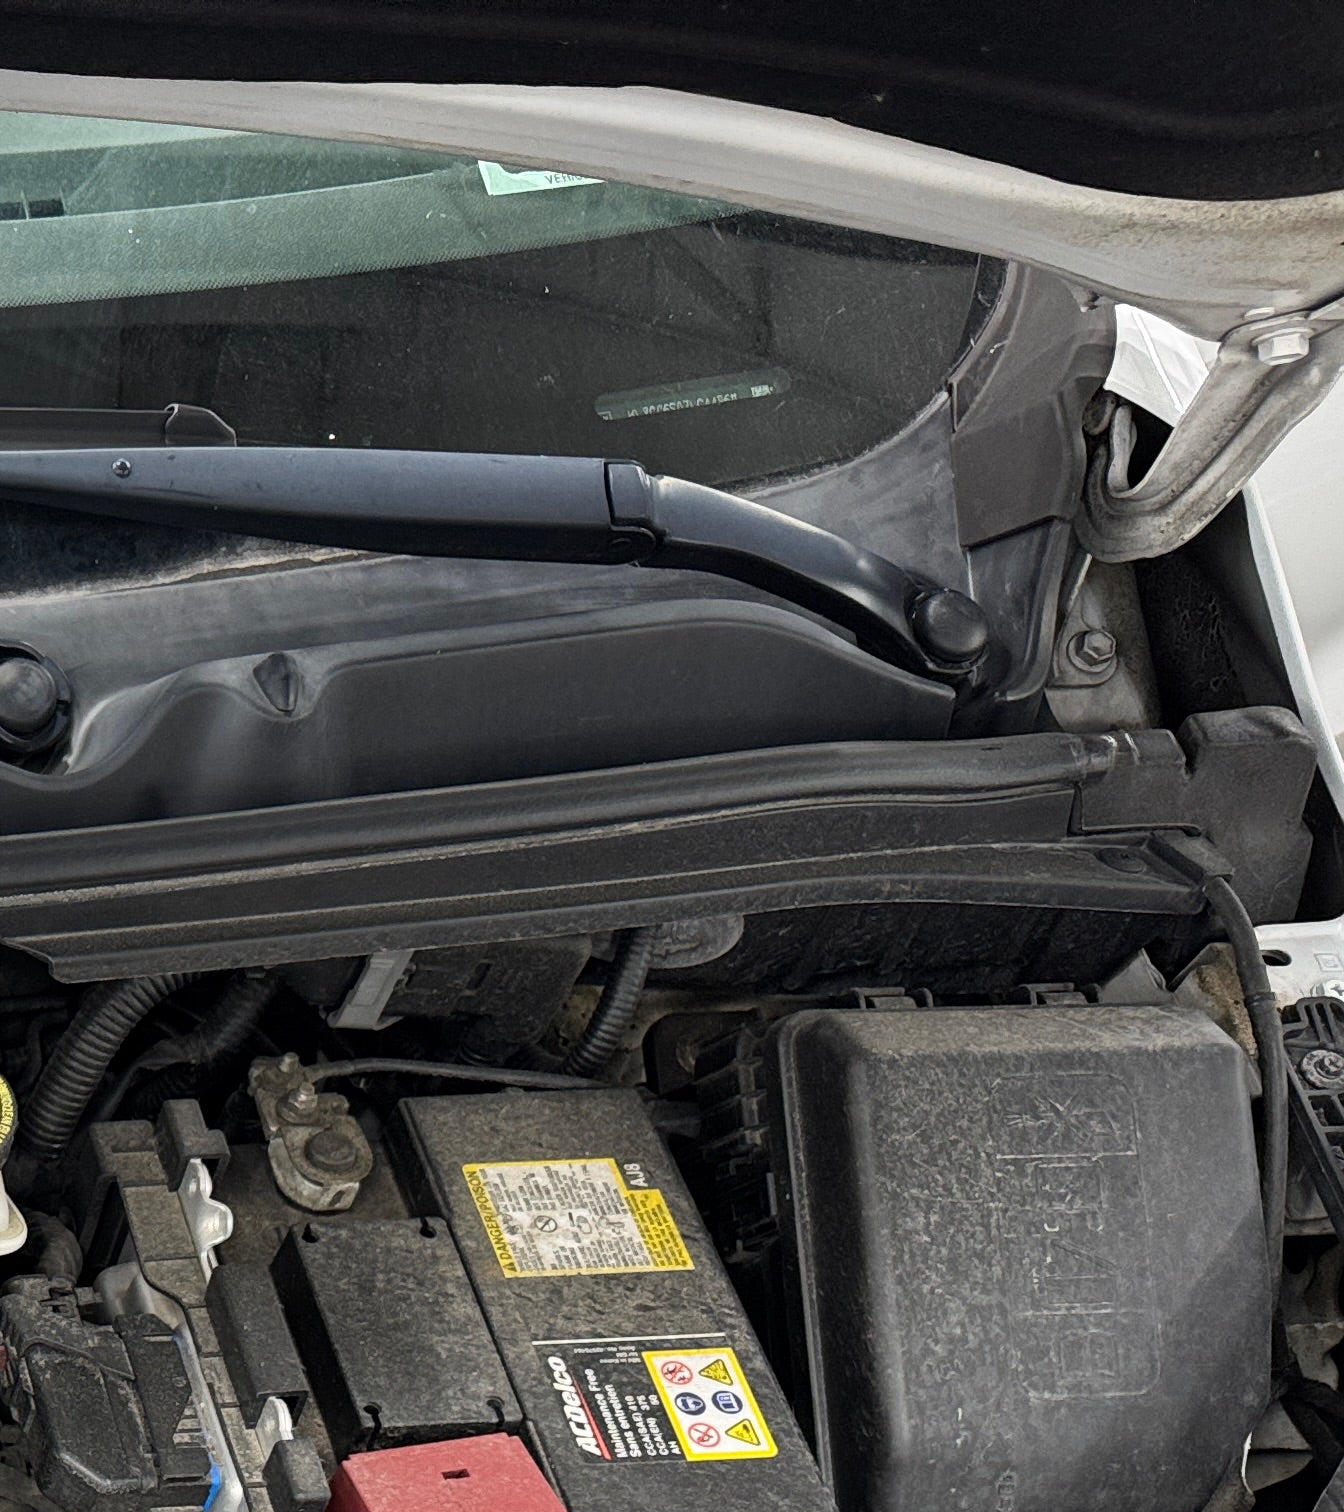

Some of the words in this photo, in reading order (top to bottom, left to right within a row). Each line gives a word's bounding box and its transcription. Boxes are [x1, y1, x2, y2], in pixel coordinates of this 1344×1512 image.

[623, 1162, 649, 1188] AJ8
[467, 1170, 514, 1263] DANGER/POISON
[585, 1368, 602, 1392] Free
[547, 1355, 602, 1457] ACDelco
[596, 1393, 629, 1458] Maintenance
[605, 1384, 629, 1431] entretien
[626, 1431, 642, 1458] Sans
